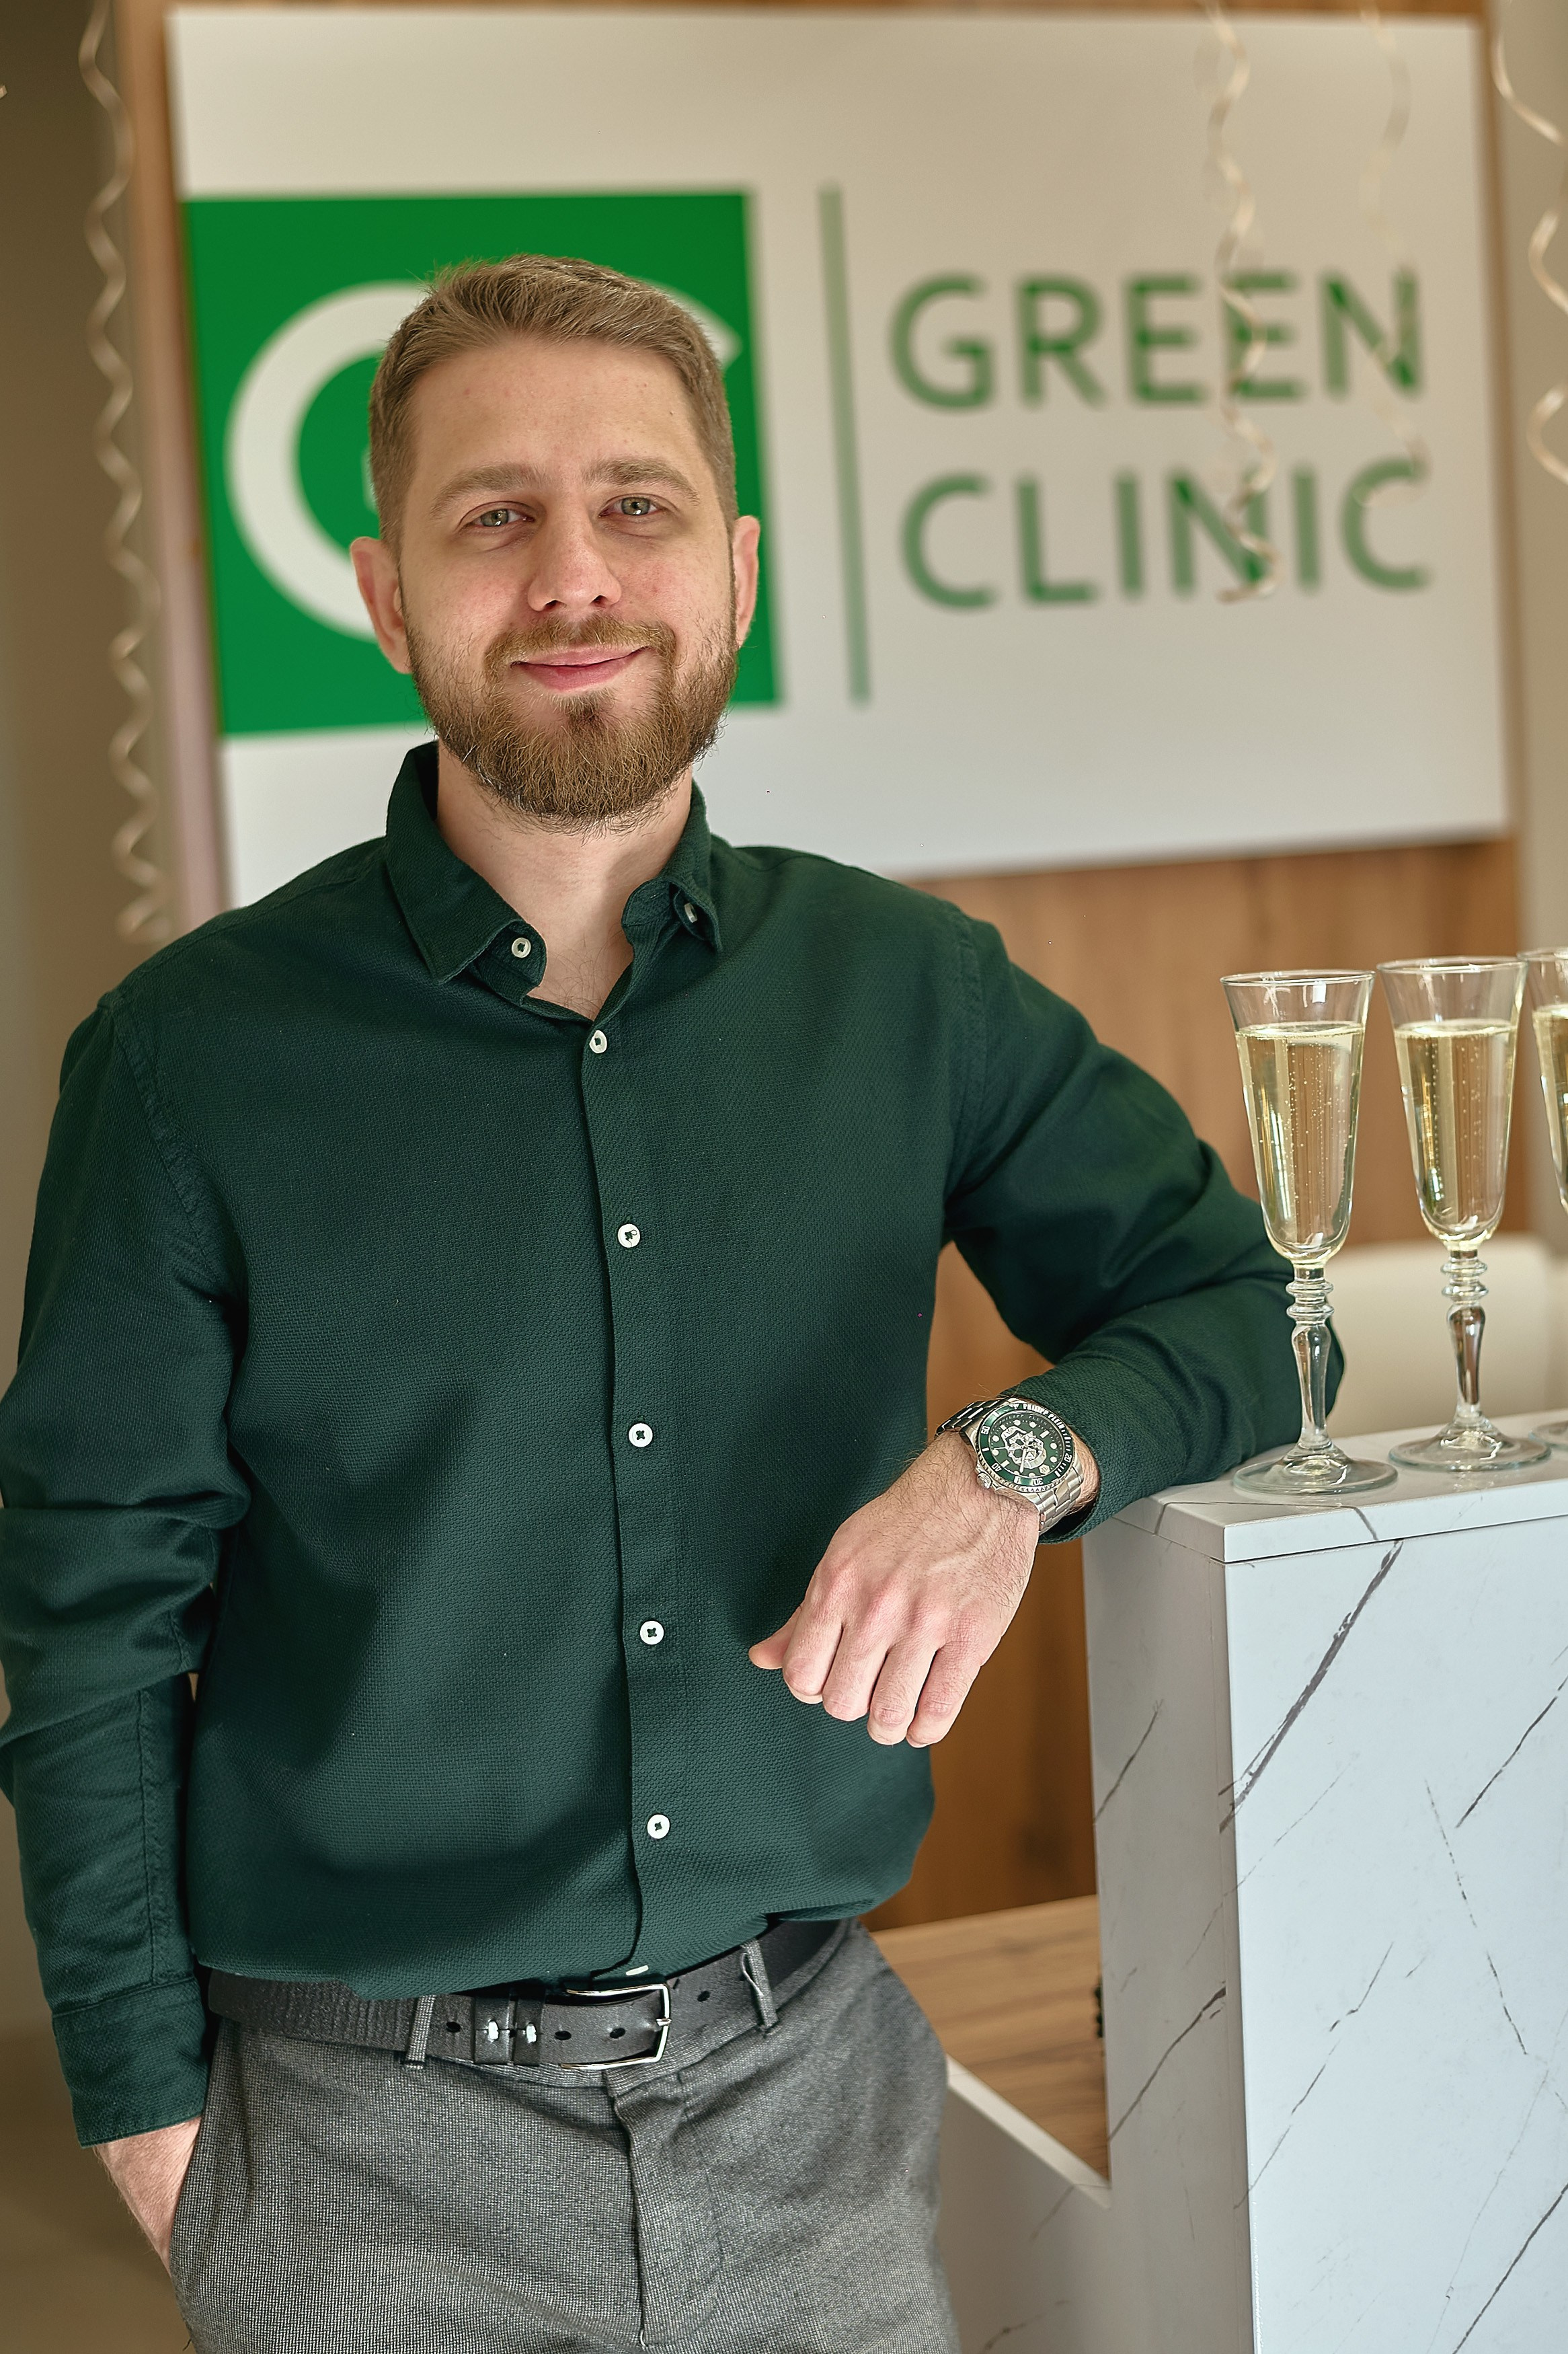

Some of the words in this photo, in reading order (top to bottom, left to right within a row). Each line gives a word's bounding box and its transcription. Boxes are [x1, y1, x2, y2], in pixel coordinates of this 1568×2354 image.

[889, 270, 1422, 409] GREEN
[901, 456, 1432, 612] CLINIC
[999, 1414, 1024, 1424] PHILIPP
[1029, 1415, 1047, 1425] PLEIN
[1048, 1413, 1065, 1429] PLEIN
[981, 1426, 990, 1435] 50
[1064, 1453, 1072, 1463] 20
[991, 1462, 1003, 1472] 40
[1033, 1477, 1044, 1486] 30
